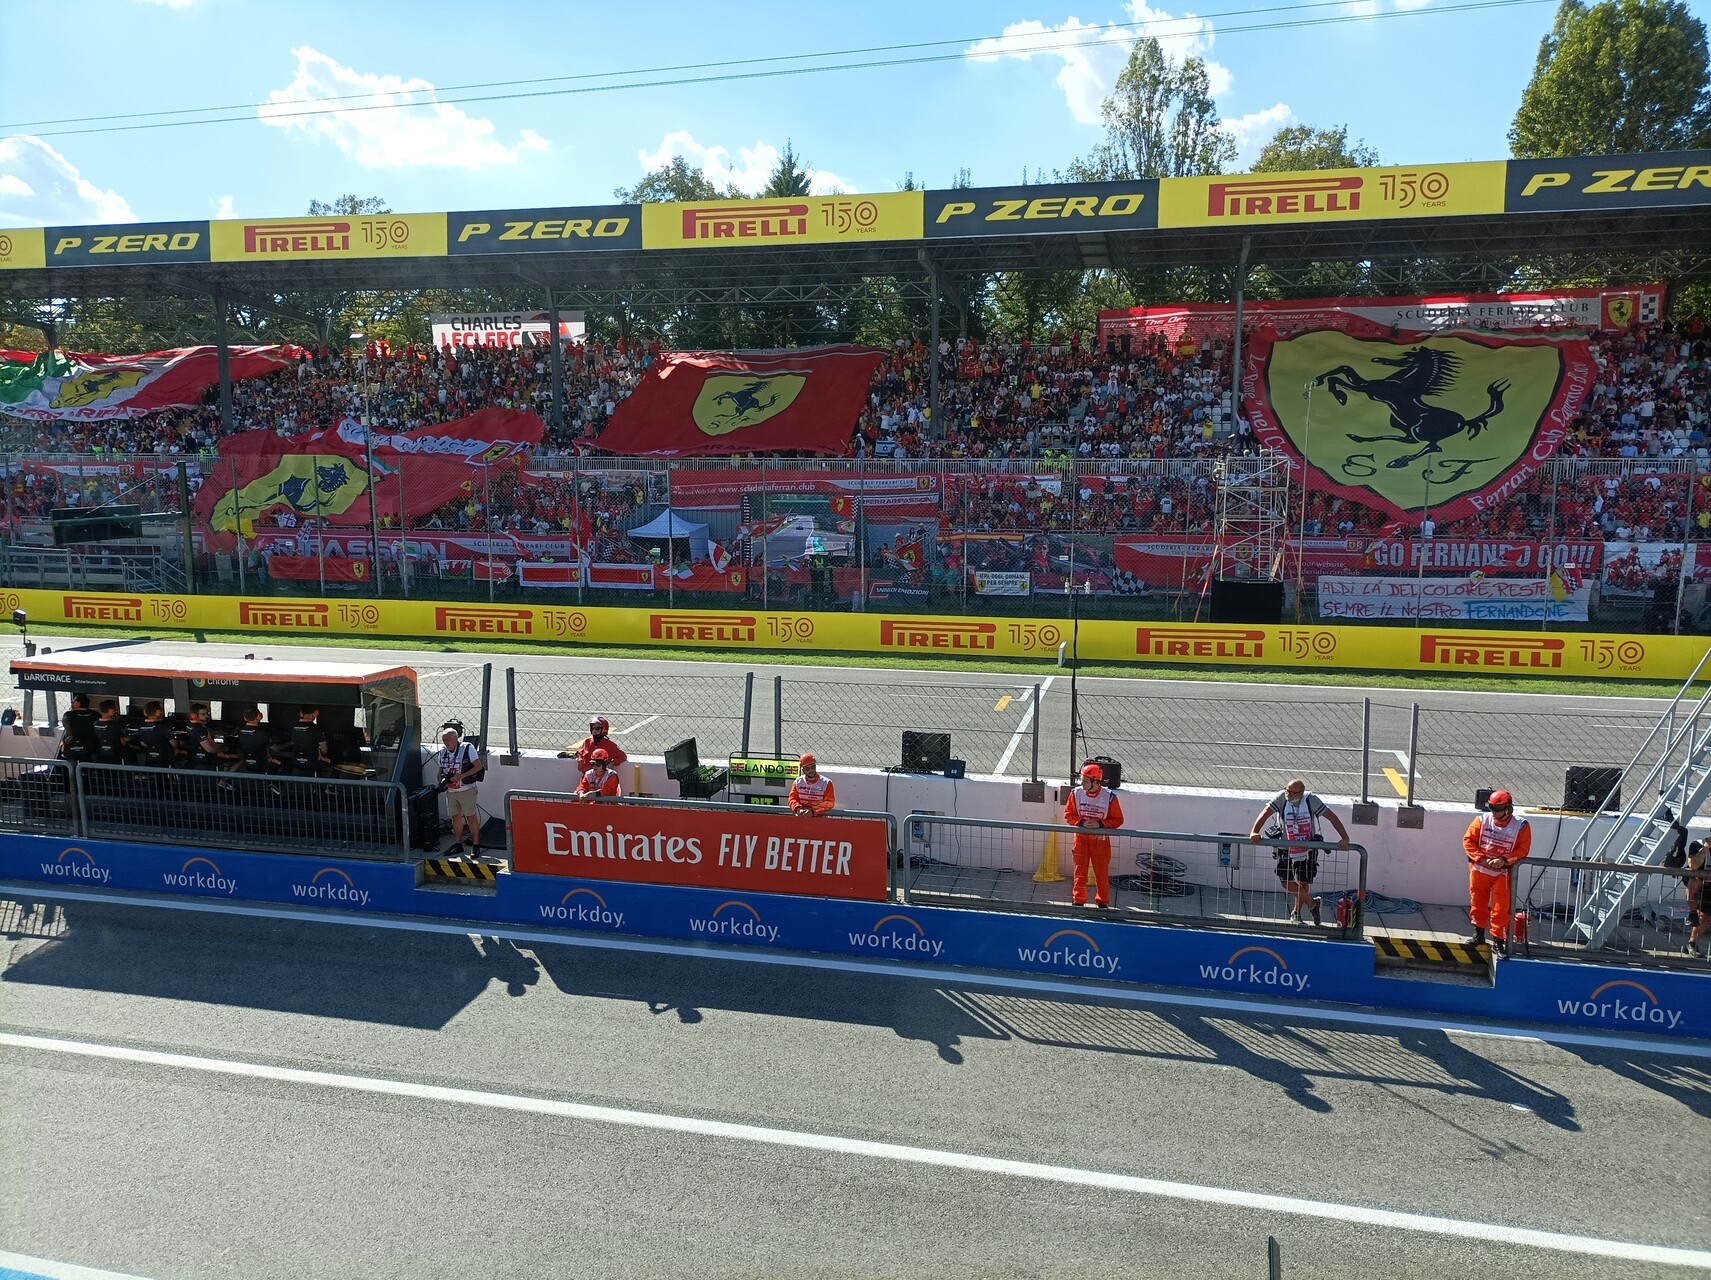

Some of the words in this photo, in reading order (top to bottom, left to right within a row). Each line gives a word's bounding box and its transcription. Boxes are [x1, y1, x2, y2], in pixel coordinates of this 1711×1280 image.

[1379, 171, 1450, 208] 150
[1520, 172, 1571, 196] P
[1581, 165, 1711, 194] ZER
[935, 202, 976, 224] P
[984, 193, 1145, 221] ZERO
[1208, 176, 1364, 216] PIRELLI
[1421, 200, 1447, 208] YEARS
[457, 223, 491, 242] P
[498, 217, 630, 241] ZERO
[682, 204, 809, 239] PIRELLI
[821, 200, 878, 234] 150
[54, 237, 82, 255] P
[88, 232, 200, 254] ZERO
[244, 222, 351, 253] PIRELLI
[361, 220, 410, 250] 150
[451, 315, 522, 331] CHARLES
[1103, 320, 1139, 329] Where
[1144, 318, 1164, 326] The
[1263, 312, 1312, 321] Passion
[1397, 307, 1471, 320] SCUDERIA
[1479, 304, 1541, 316] FERRARI
[1550, 303, 1589, 313] CLUB
[441, 330, 521, 350] LECLERC
[1468, 463, 1535, 511] Ferrari
[1374, 542, 1405, 567] GO
[1388, 583, 1420, 597] DEL
[63, 595, 142, 621] PIRELLI
[150, 600, 187, 623] 150
[239, 602, 329, 627] PIRELLI
[338, 604, 379, 629] 150
[435, 607, 533, 634] PIRELLI
[543, 610, 587, 636] 150
[1402, 602, 1461, 618] NOSTRO
[1463, 601, 1570, 619] FERNANDONE
[650, 614, 757, 641] PIRELLI
[767, 616, 814, 643] 150
[880, 620, 997, 649] PIRELLI
[1008, 623, 1061, 651] 150
[1136, 627, 1266, 658] PIRELLI
[1278, 630, 1337, 660] 150
[1419, 635, 1565, 668] PIRELLI
[1580, 639, 1645, 670] 150
[24, 673, 71, 683] DARKTRACE
[745, 764, 785, 774] LANDO
[544, 822, 703, 864] Emirates
[718, 833, 758, 868] FLY
[764, 836, 853, 876] BETTER
